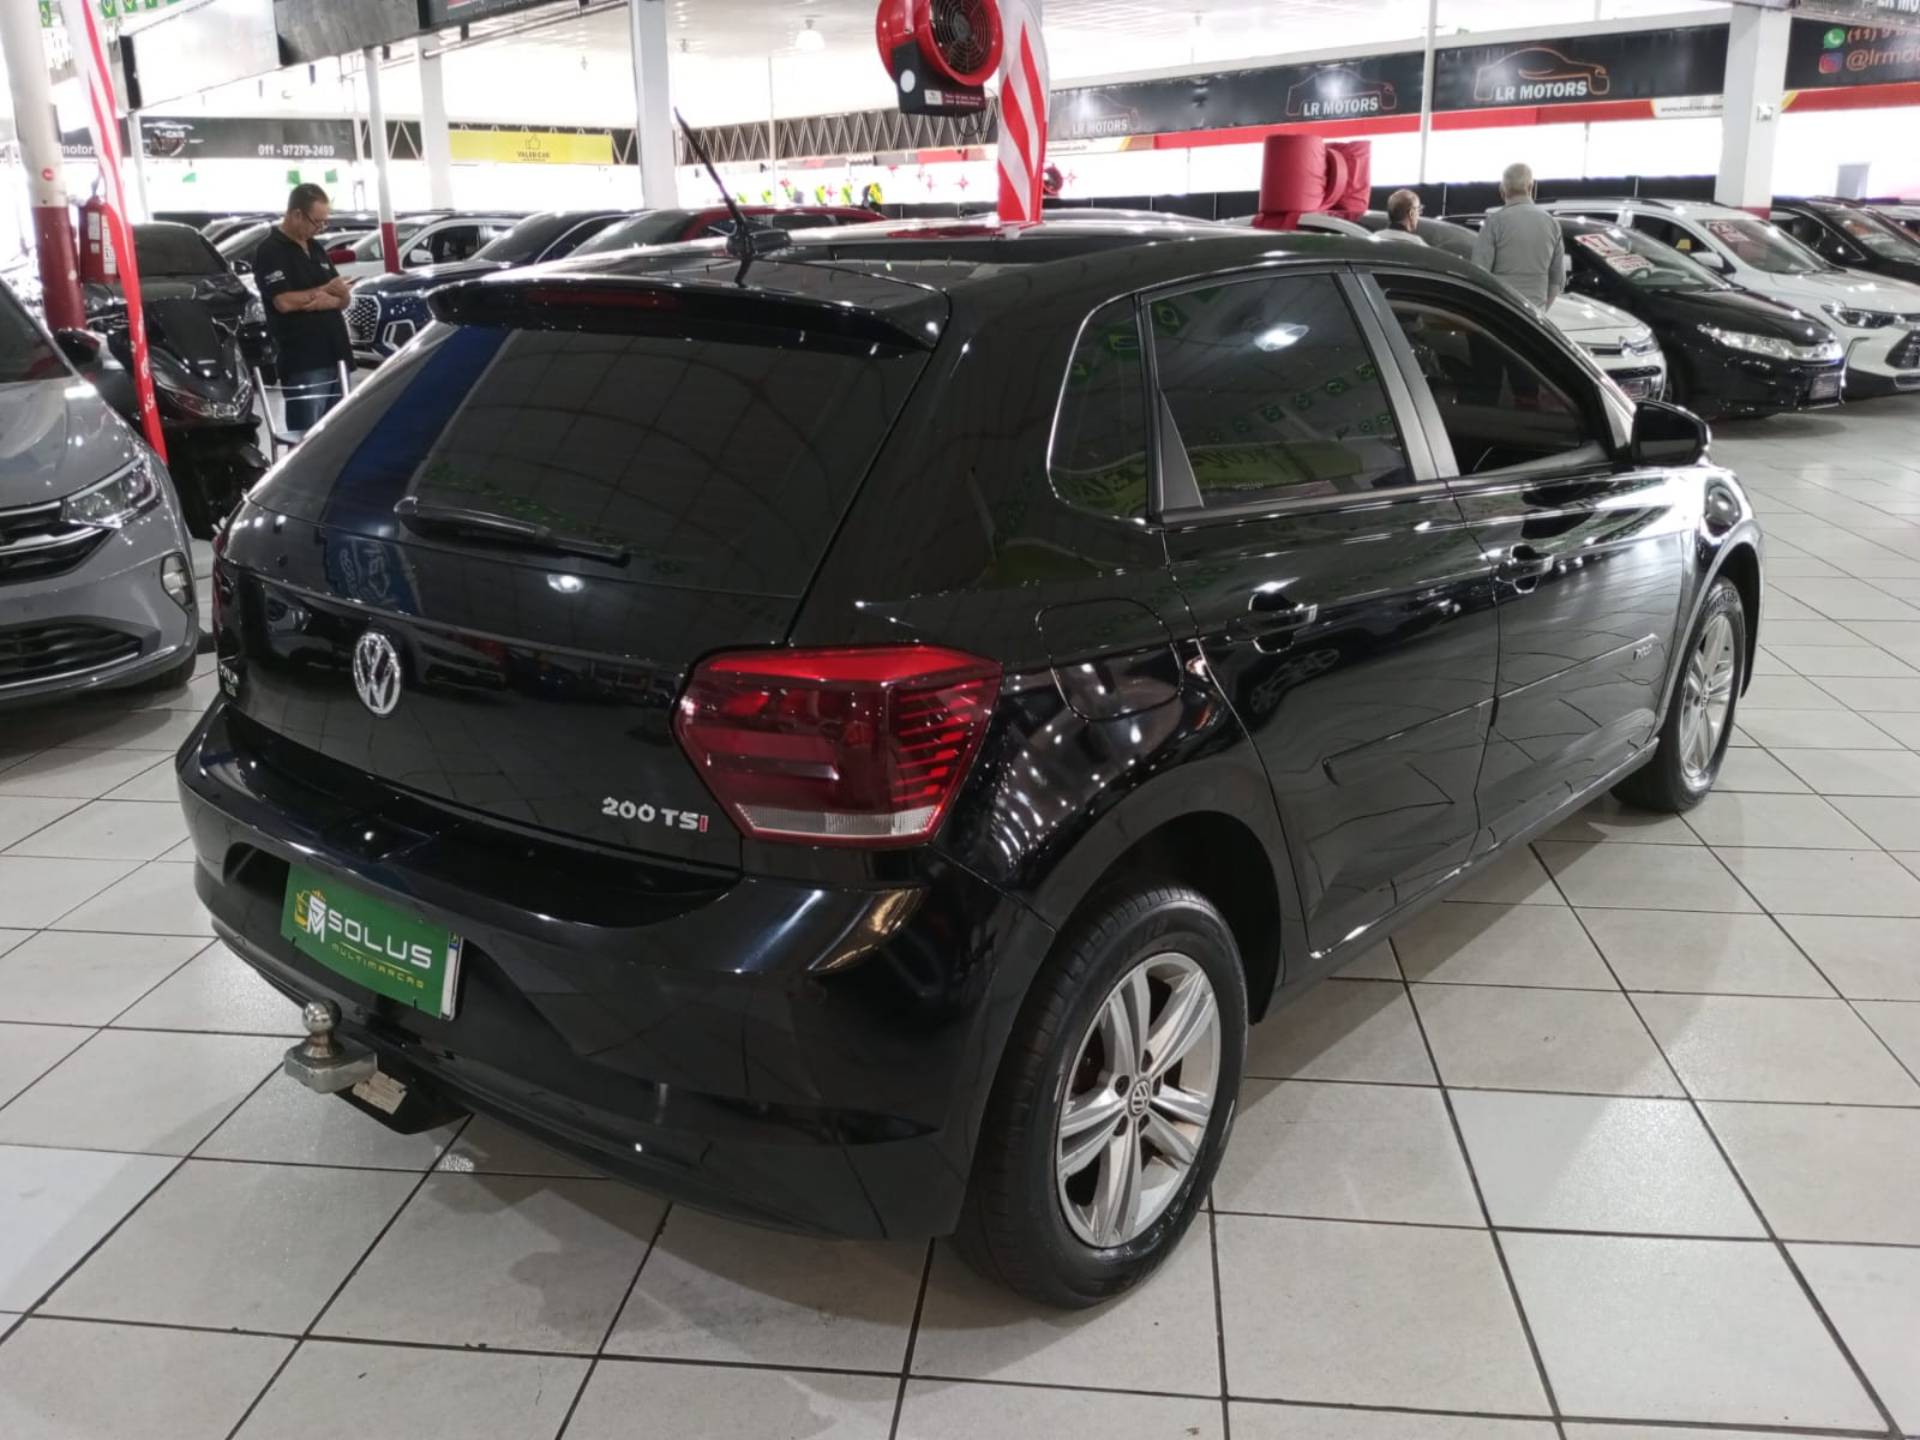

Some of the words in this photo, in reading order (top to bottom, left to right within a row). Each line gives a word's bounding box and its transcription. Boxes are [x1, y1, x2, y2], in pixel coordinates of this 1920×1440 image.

[1495, 85, 1515, 101] LR
[1520, 81, 1587, 99] MOTORS
[1303, 101, 1320, 116] LR
[1323, 96, 1379, 115] MOTORS
[257, 143, 274, 156] 011
[601, 796, 656, 823] 200
[327, 908, 434, 970] SOLUS
[331, 942, 426, 990] MULTIMARCAS
